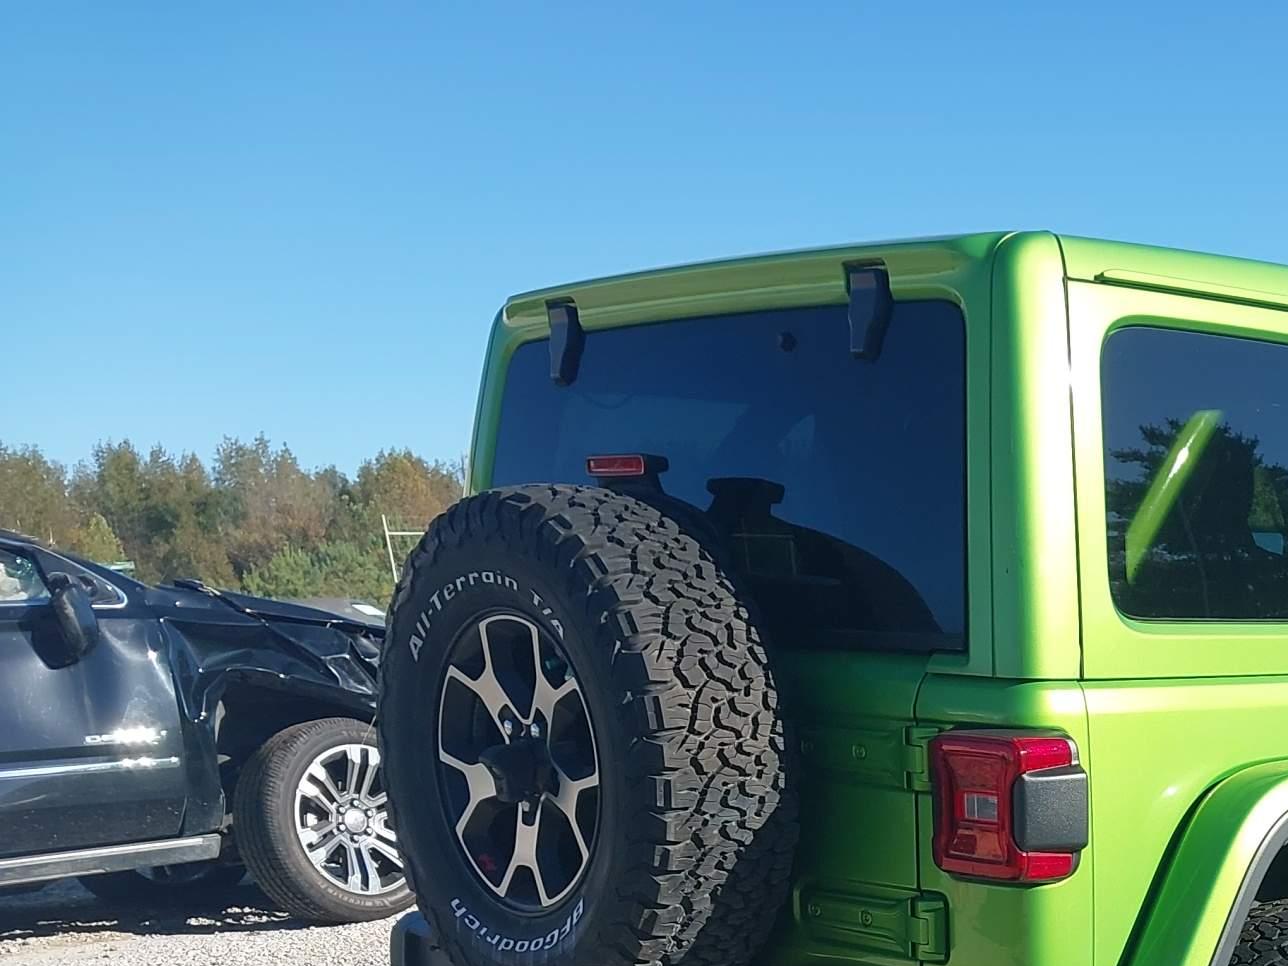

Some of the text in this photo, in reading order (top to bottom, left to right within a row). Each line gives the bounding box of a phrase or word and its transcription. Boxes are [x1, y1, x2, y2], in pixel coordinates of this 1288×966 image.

[409, 571, 564, 662] All-Terrain T/A
[451, 898, 584, 953] BFGoodrich
